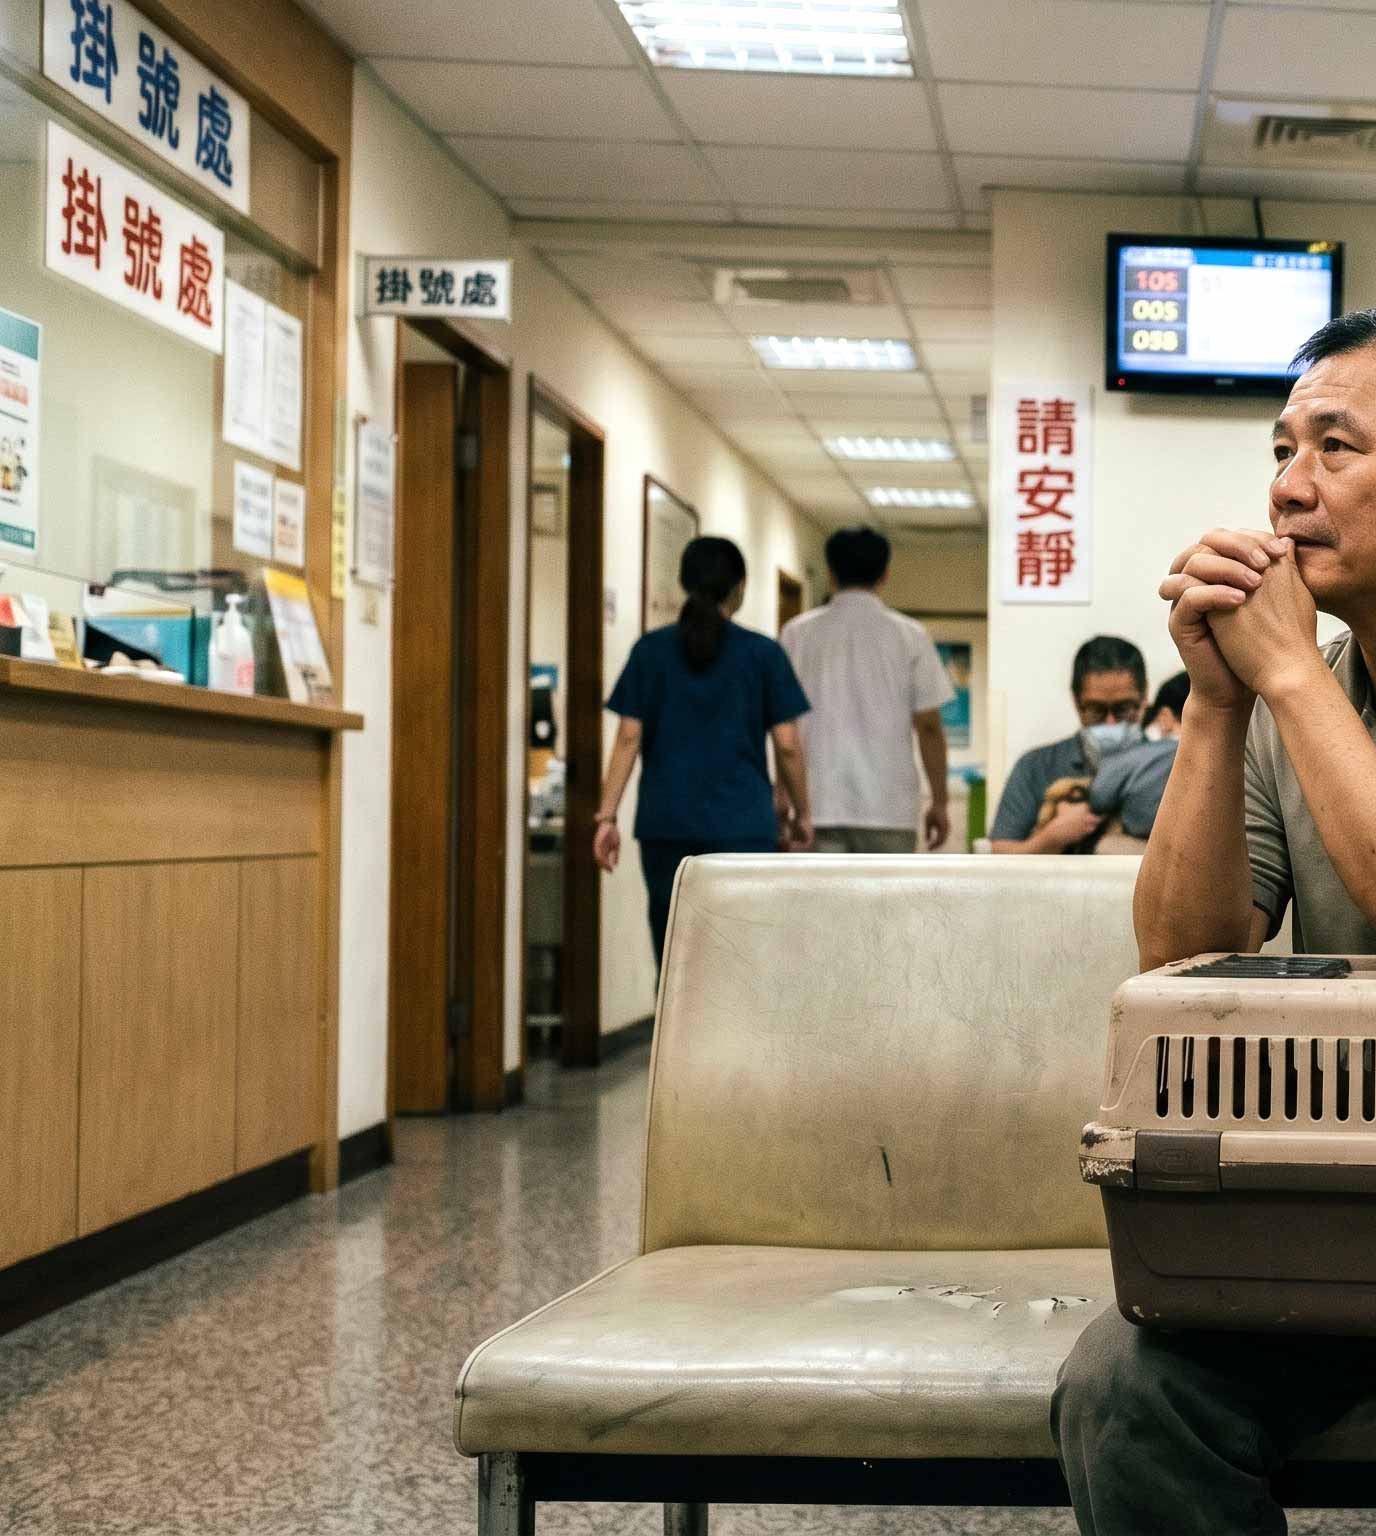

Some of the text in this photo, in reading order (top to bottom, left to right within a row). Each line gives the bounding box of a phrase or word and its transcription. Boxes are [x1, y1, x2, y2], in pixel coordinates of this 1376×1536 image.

[69, 0, 233, 187] 掛號處
[61, 157, 213, 328] 掛號處
[1132, 300, 1178, 321] 005
[1136, 270, 1178, 292] 105
[1016, 398, 1076, 587] 請安靜
